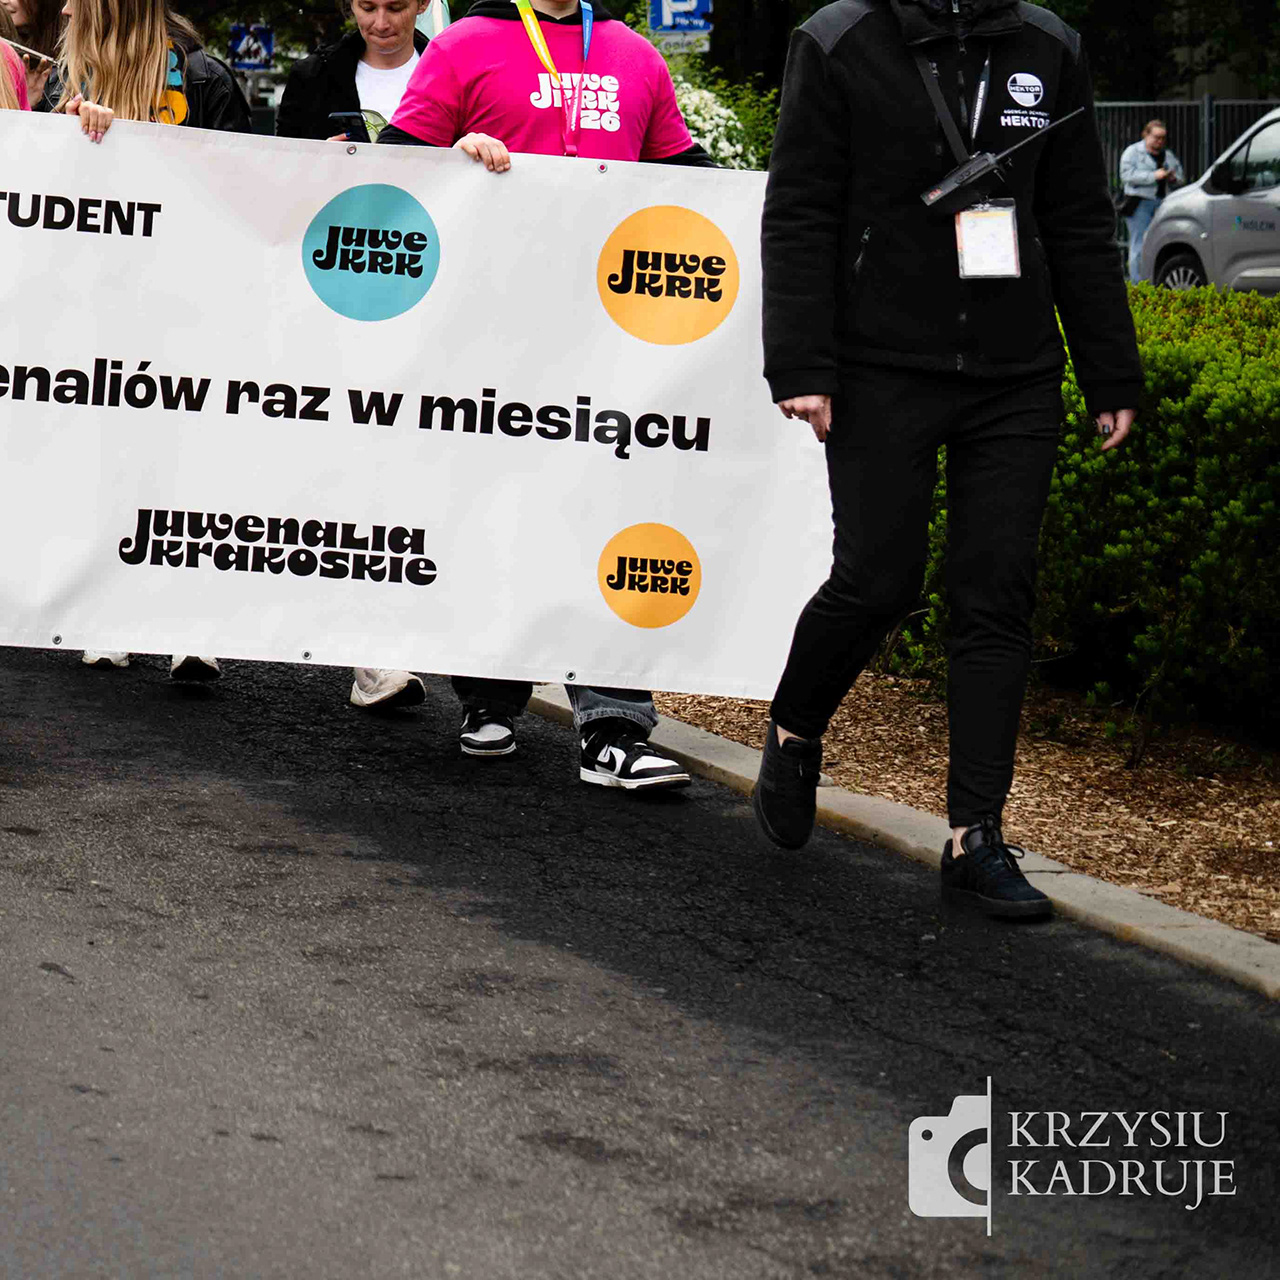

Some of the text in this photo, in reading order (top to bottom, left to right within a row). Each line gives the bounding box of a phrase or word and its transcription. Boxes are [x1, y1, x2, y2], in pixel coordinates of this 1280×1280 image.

[1009, 85, 1040, 93] HEKTOR
[1000, 115, 1050, 129] HEKTOR
[226, 381, 330, 421] raz
[348, 390, 403, 426] w
[419, 388, 710, 459] miesiącu
